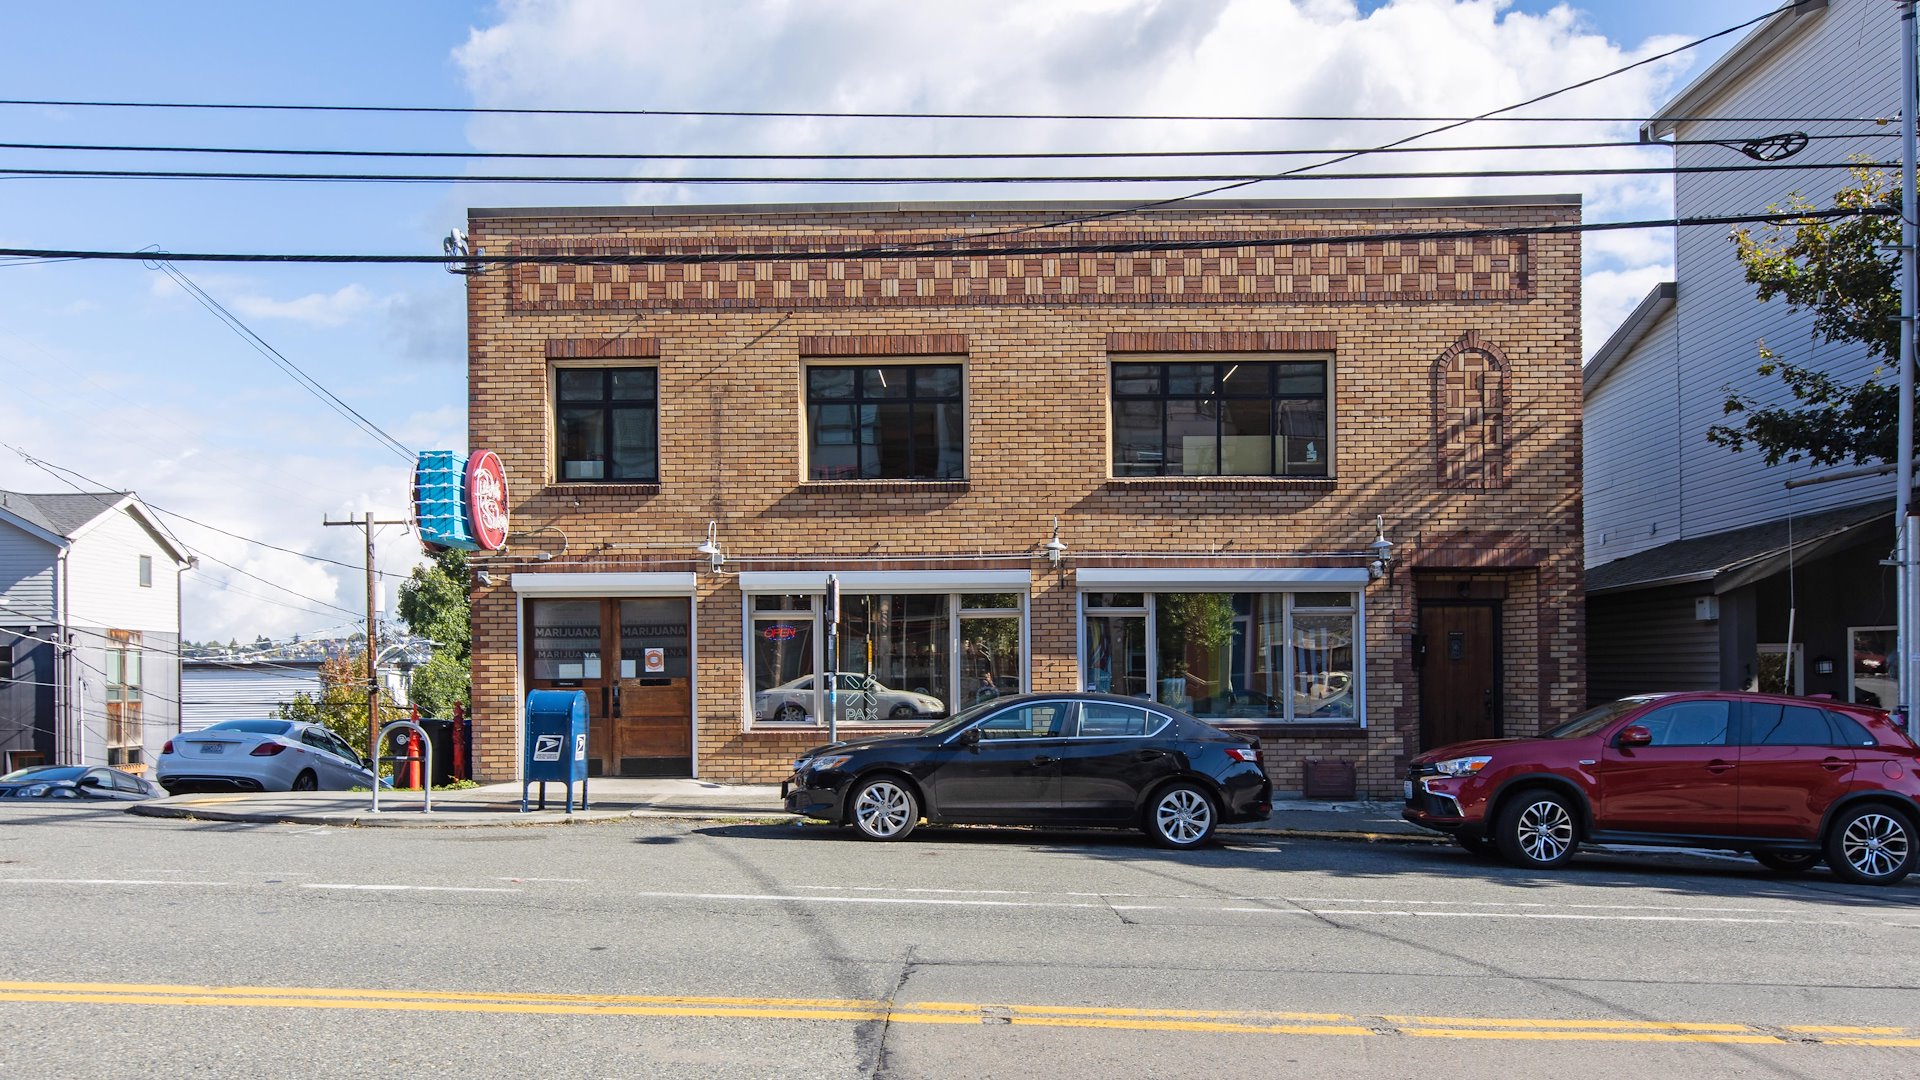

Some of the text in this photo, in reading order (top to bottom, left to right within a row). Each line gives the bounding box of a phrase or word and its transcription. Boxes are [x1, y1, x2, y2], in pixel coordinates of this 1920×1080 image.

[535, 628, 599, 637] MARIJUANA
[622, 626, 686, 636] MARIJUANA
[764, 628, 797, 638] OPEN
[538, 650, 597, 658] MARIJUANA
[845, 708, 878, 721] PAX
